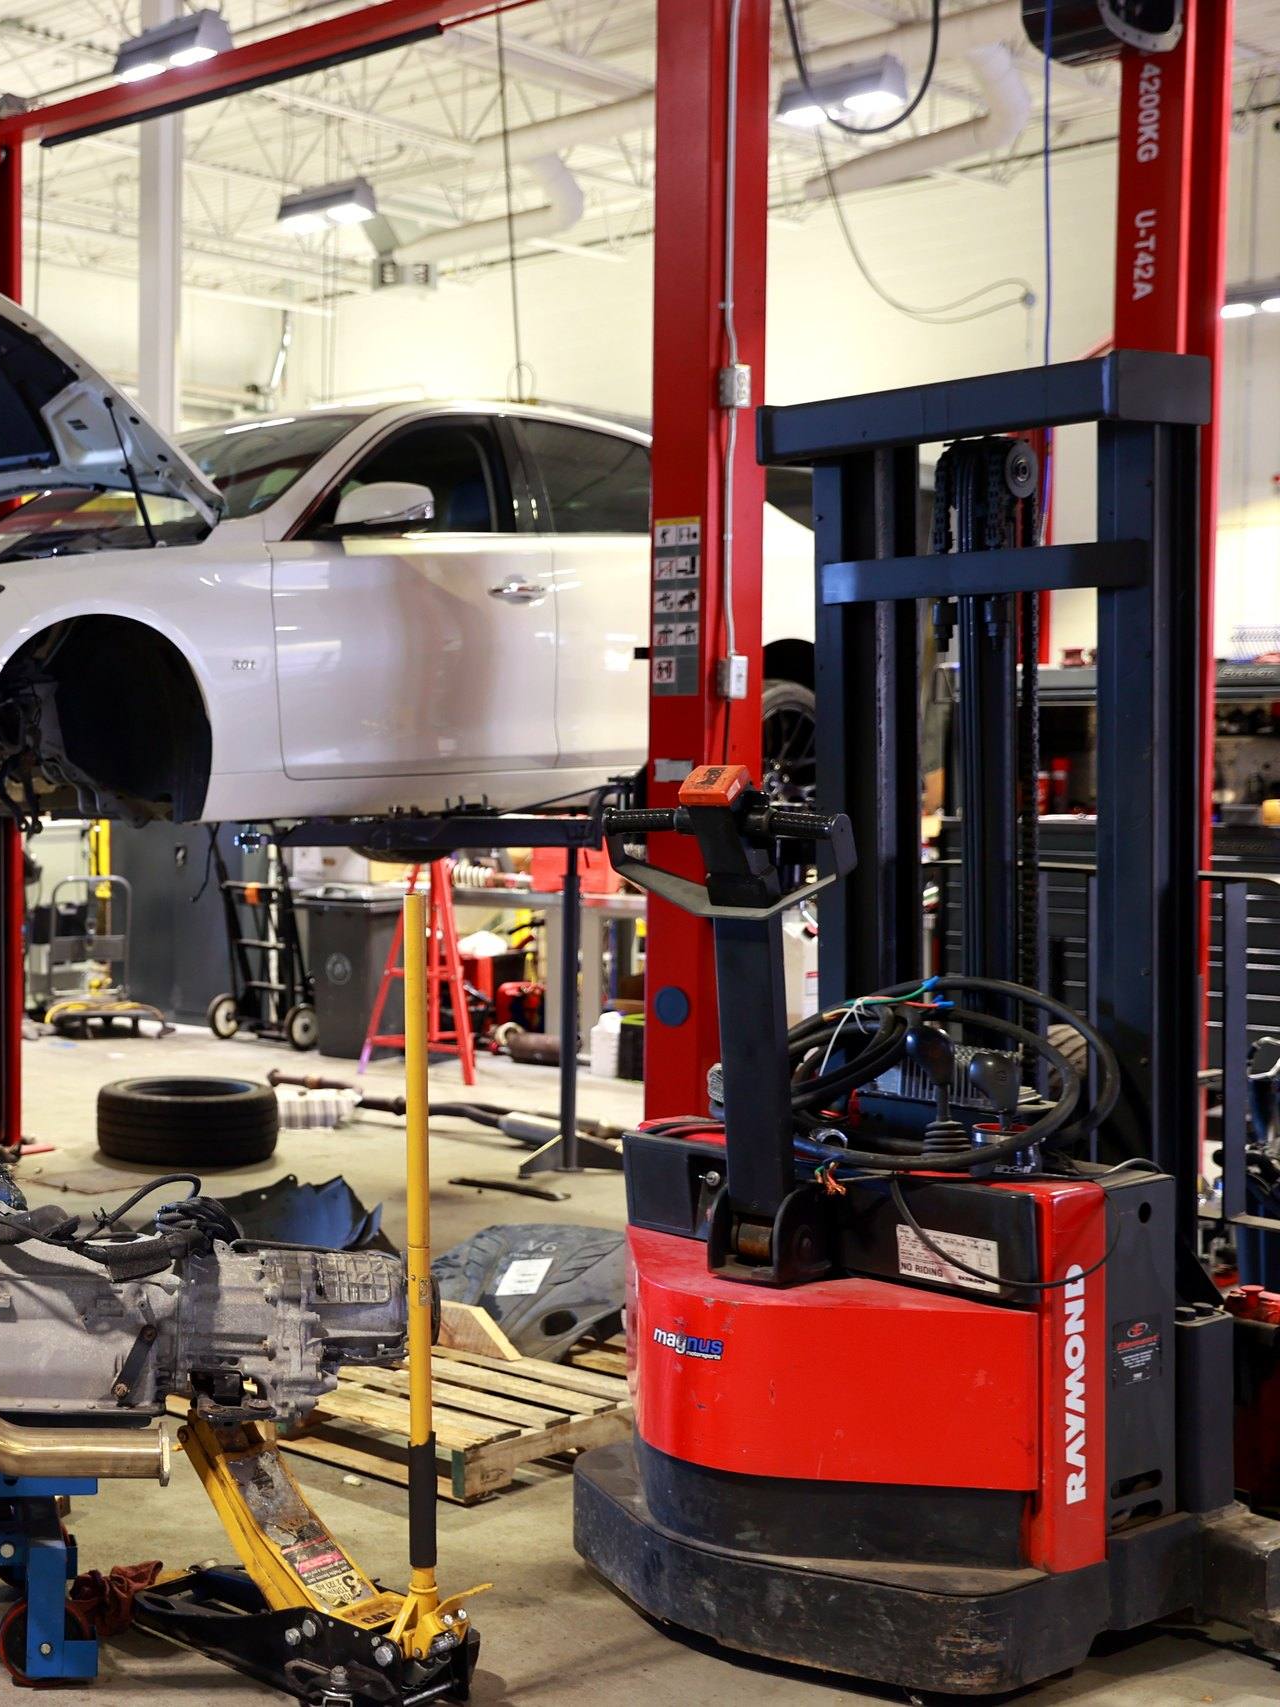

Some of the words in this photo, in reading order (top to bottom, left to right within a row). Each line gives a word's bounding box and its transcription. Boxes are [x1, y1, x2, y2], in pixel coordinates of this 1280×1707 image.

[1137, 63, 1161, 163] 4200KG
[1132, 208, 1157, 301] U-T42A
[528, 1240, 559, 1252] V6
[901, 1262, 912, 1271] NO
[915, 1264, 944, 1278] RIDING
[653, 1328, 723, 1355] magnus
[1064, 1263, 1086, 1505] RAYMOND
